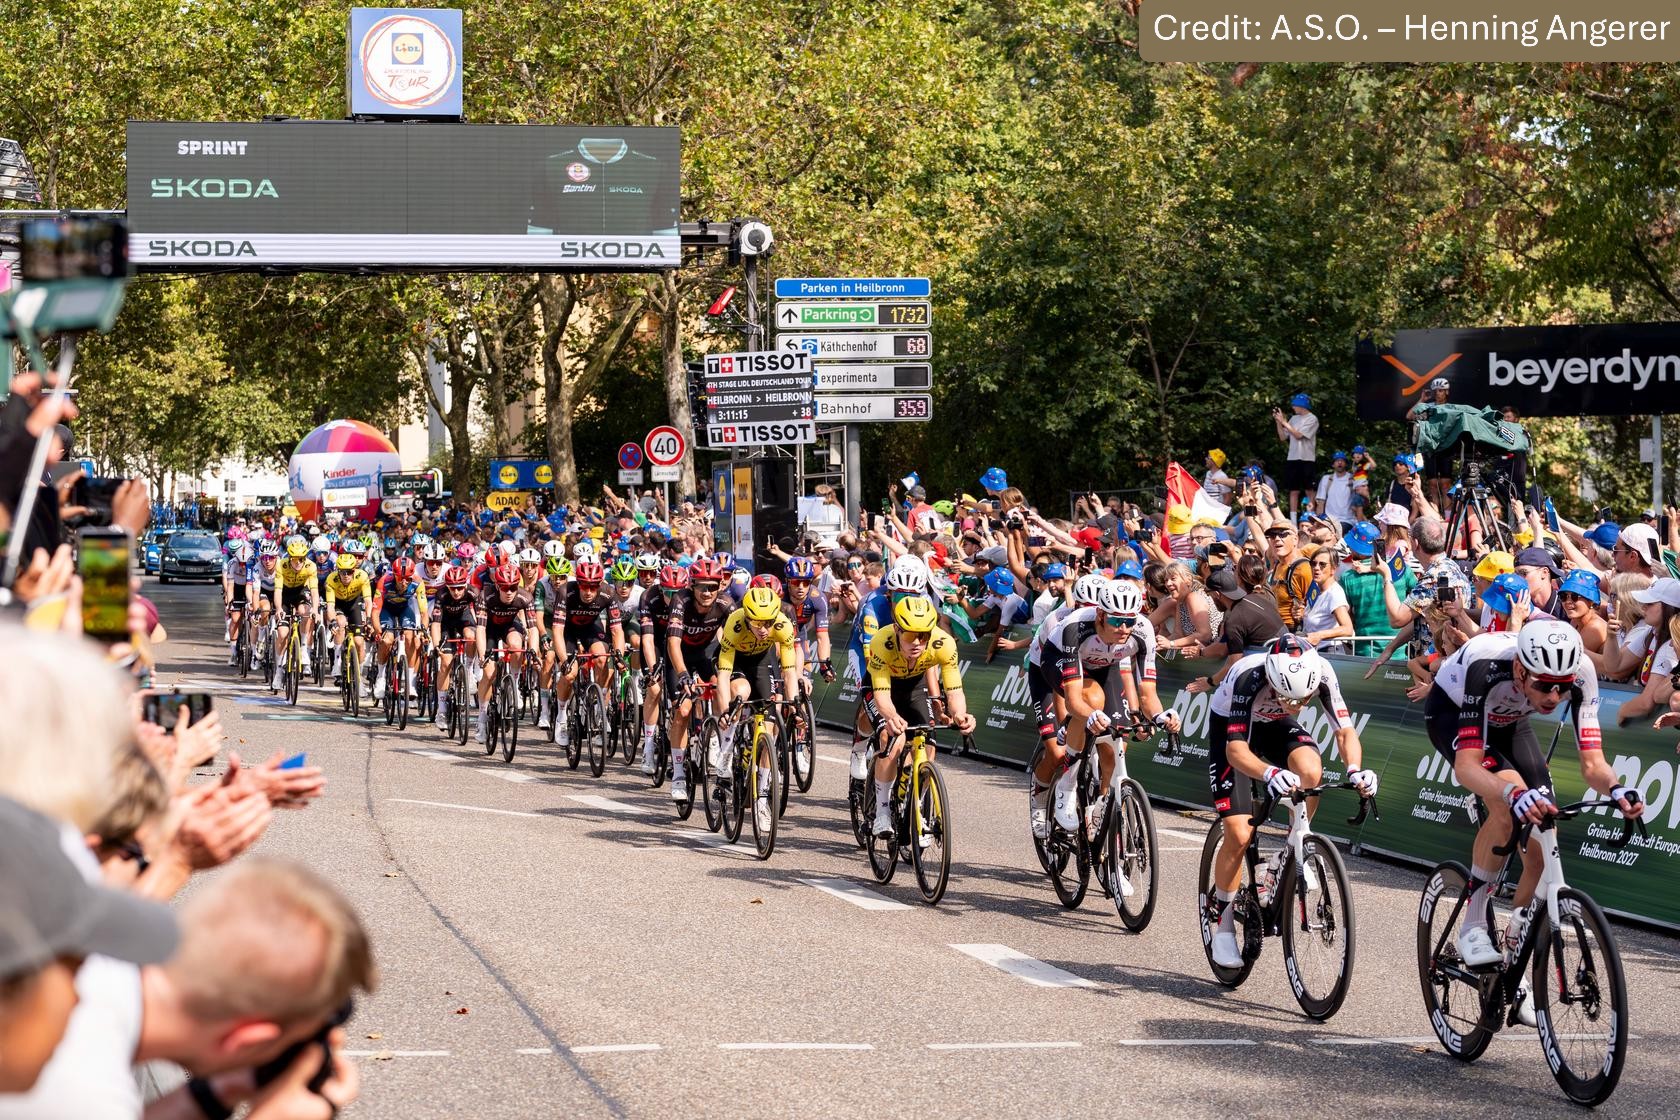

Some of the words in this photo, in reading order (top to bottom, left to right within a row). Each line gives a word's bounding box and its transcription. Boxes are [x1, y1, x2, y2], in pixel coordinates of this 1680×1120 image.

[177, 140, 248, 155] SPRINT
[151, 178, 280, 198] SKODA
[149, 240, 258, 257] SKODA
[561, 242, 665, 258] SKODA
[801, 283, 837, 292] Parken
[841, 283, 851, 292] in
[854, 283, 905, 292] Heilbronn
[804, 308, 857, 322] Parkring
[890, 307, 926, 323] 1732
[820, 340, 877, 352] Käthchenhof
[906, 338, 926, 353] 68
[736, 353, 807, 372] TISSOT
[1489, 348, 1680, 393] beyerdyn
[719, 380, 736, 388] STAGE
[751, 378, 794, 387] DEUTSCHLAND
[821, 372, 877, 384] experimenta
[707, 394, 752, 405] HEILBRONN
[765, 391, 812, 403] HEILBRONN
[718, 409, 749, 420] 3:11:15
[821, 402, 871, 414] Bahnhof
[898, 400, 926, 416] 359
[738, 424, 811, 442] TISSOT
[654, 437, 677, 455] 40
[495, 496, 520, 505] ADAC
[1209, 763, 1218, 793] UAE
[1419, 787, 1435, 801] Grüne
[1434, 791, 1464, 808] Hauptstadt
[1411, 804, 1437, 820] Heilbronn
[1435, 809, 1452, 823] 2027
[1587, 822, 1611, 840] Grüne
[1579, 841, 1617, 863] Heilbronn
[1616, 850, 1640, 866] 2027
[1511, 898, 1538, 965] COLNAGO
